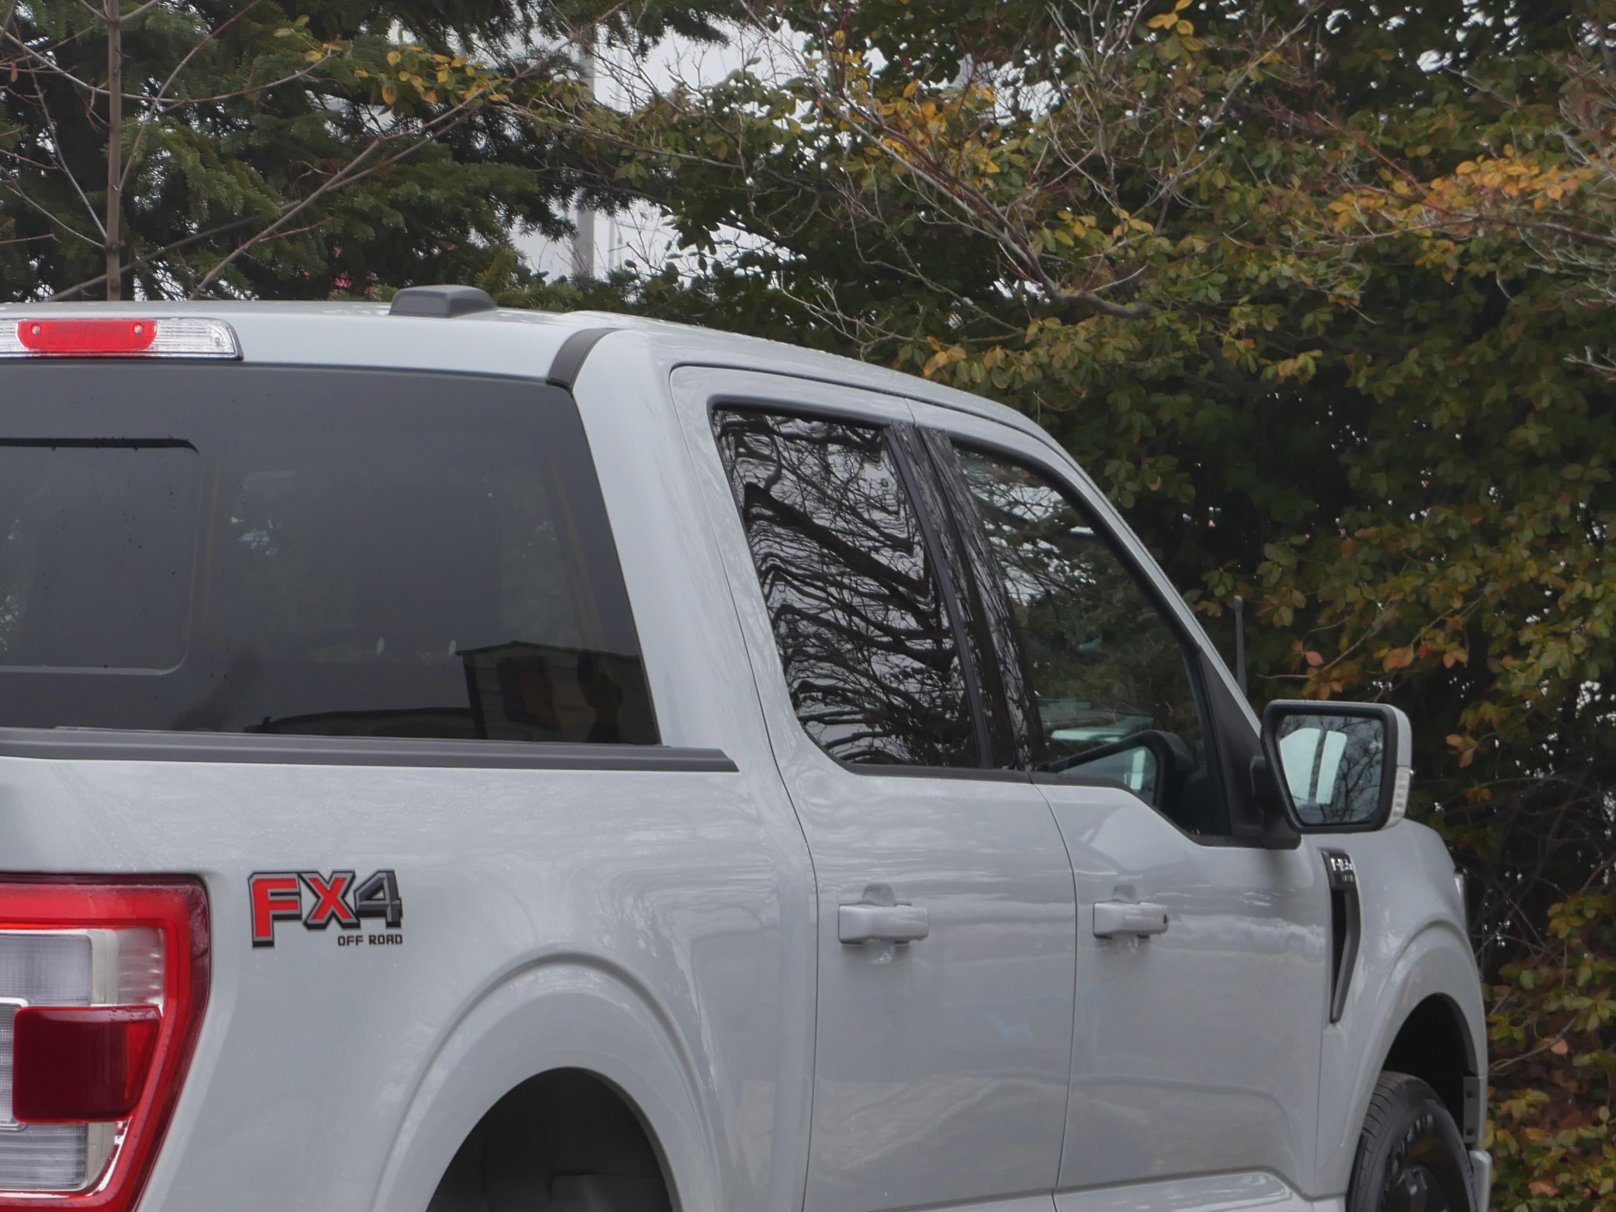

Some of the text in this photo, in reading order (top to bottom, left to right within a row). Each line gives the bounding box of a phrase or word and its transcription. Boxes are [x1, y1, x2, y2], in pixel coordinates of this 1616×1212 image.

[247, 869, 403, 948] FX4
[337, 934, 403, 946] OFF ROAD
